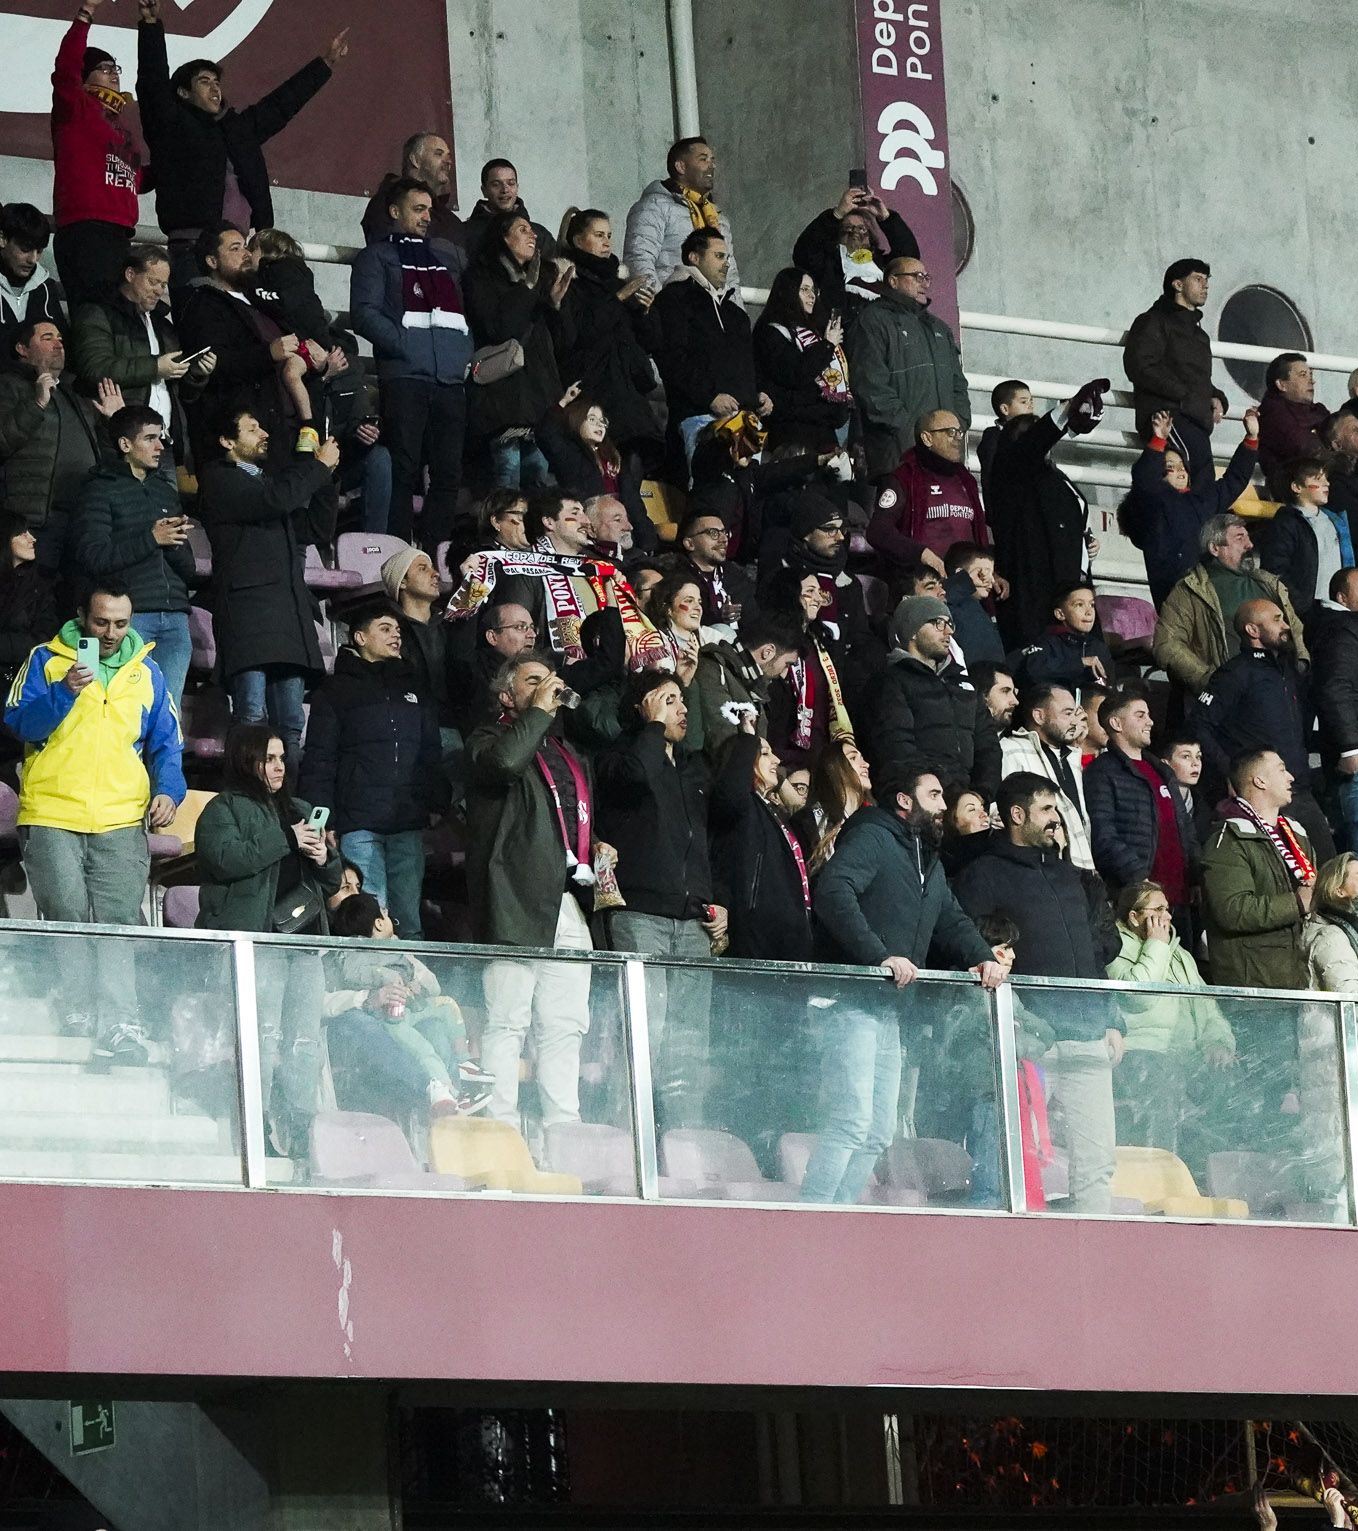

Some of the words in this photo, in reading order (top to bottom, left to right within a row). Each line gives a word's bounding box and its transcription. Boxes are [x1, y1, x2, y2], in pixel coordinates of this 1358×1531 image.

[871, 0, 904, 76] Dep
[906, 3, 933, 81] Pon
[505, 552, 537, 563] COPA
[540, 555, 558, 564] DEL
[561, 557, 583, 566] REY
